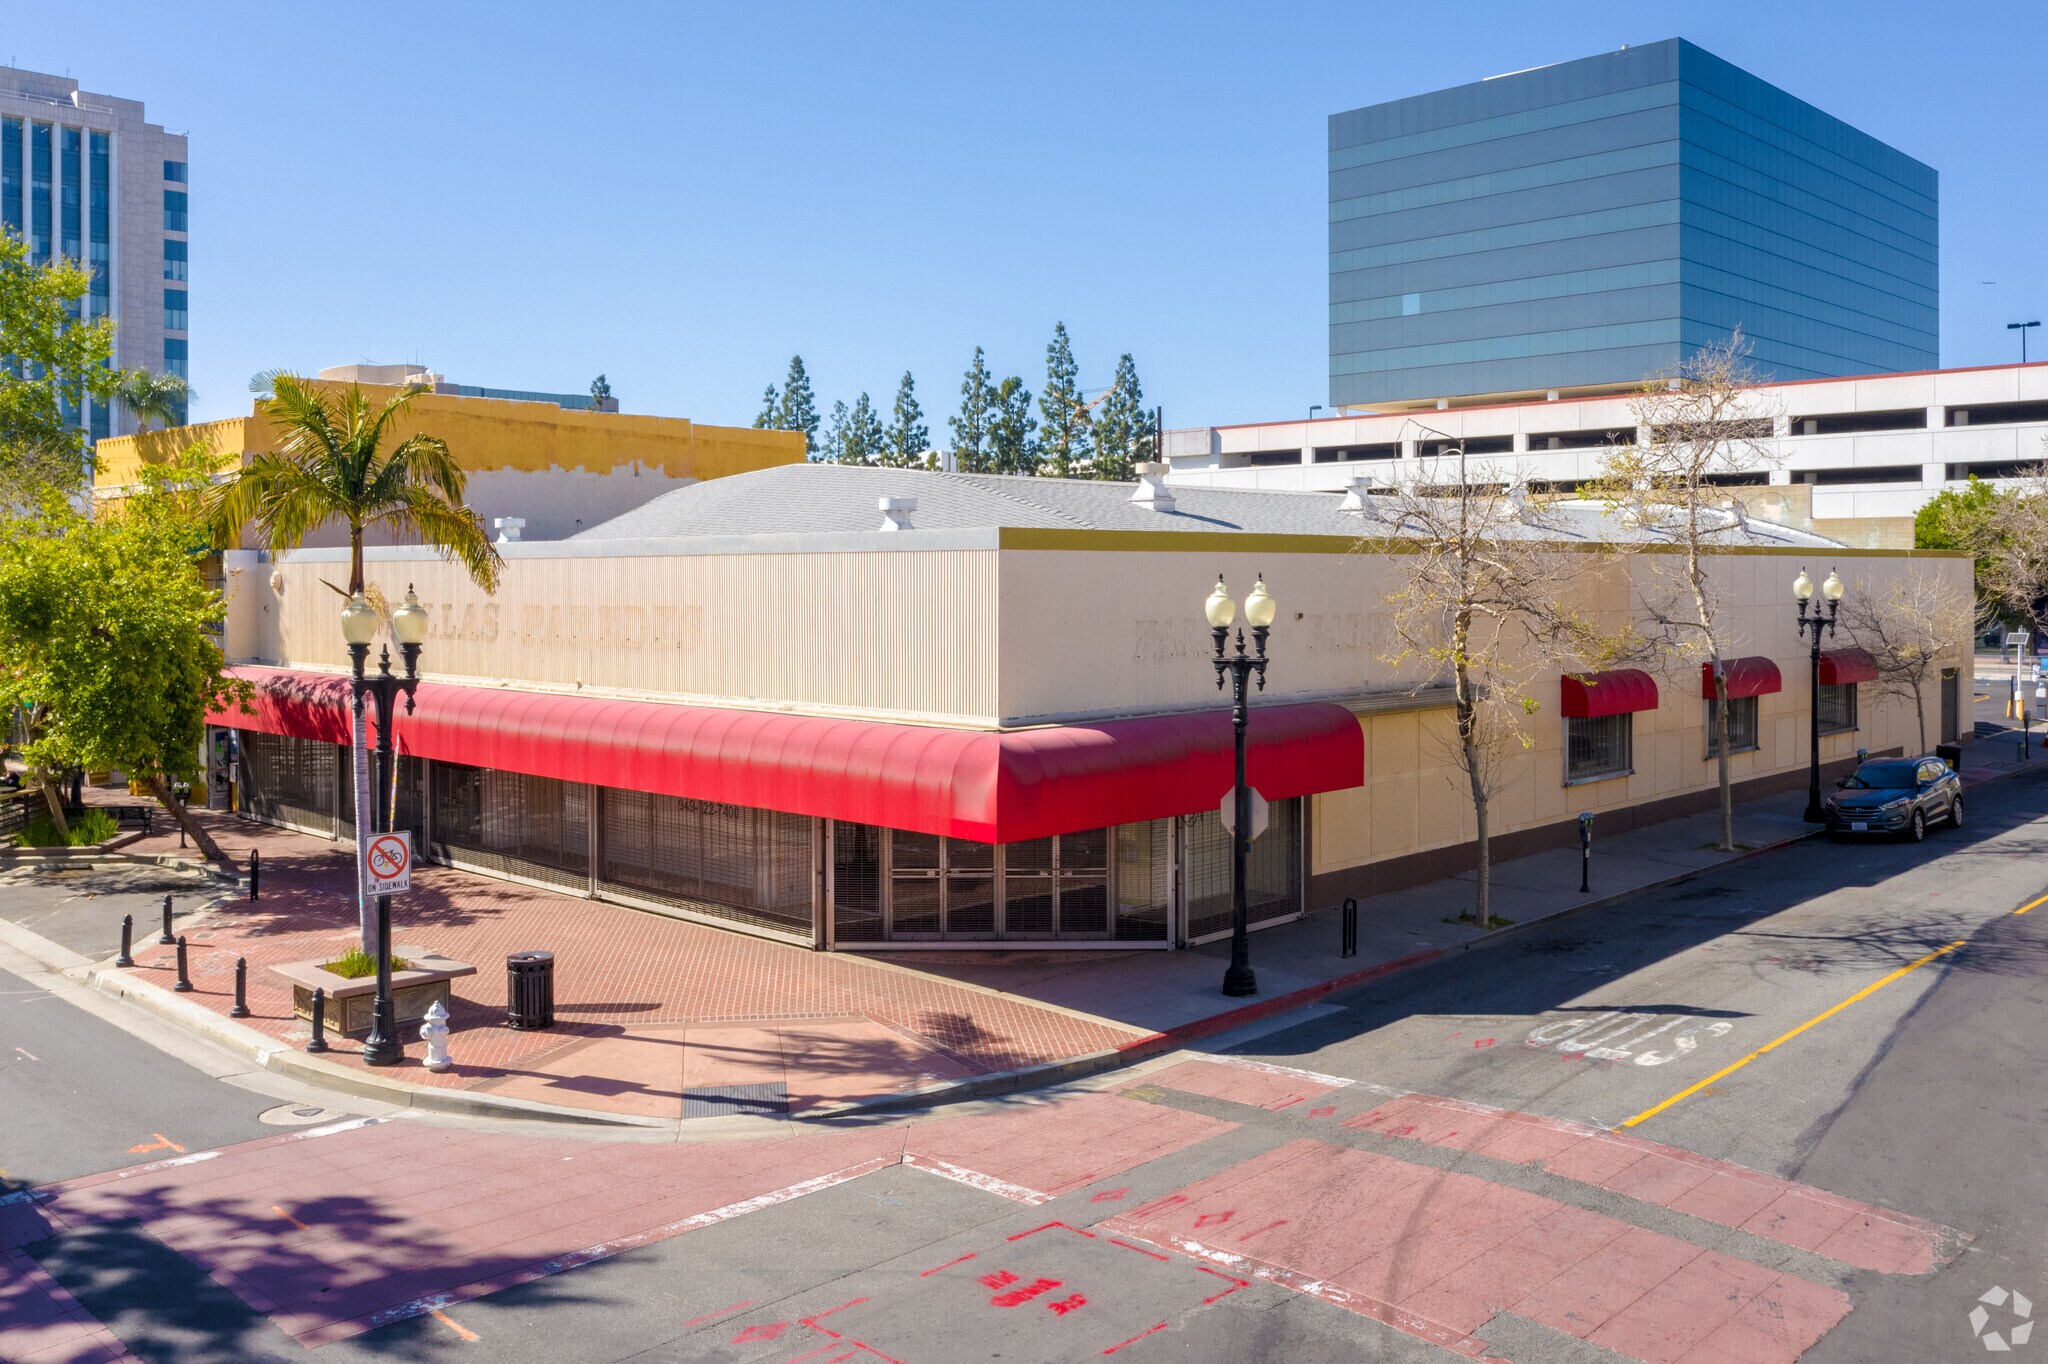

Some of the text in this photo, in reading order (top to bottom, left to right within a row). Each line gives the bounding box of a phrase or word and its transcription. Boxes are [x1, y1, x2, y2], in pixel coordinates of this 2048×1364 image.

[368, 880, 408, 893] ON SIDEWALK
[1525, 1008, 1733, 1066] STOP
